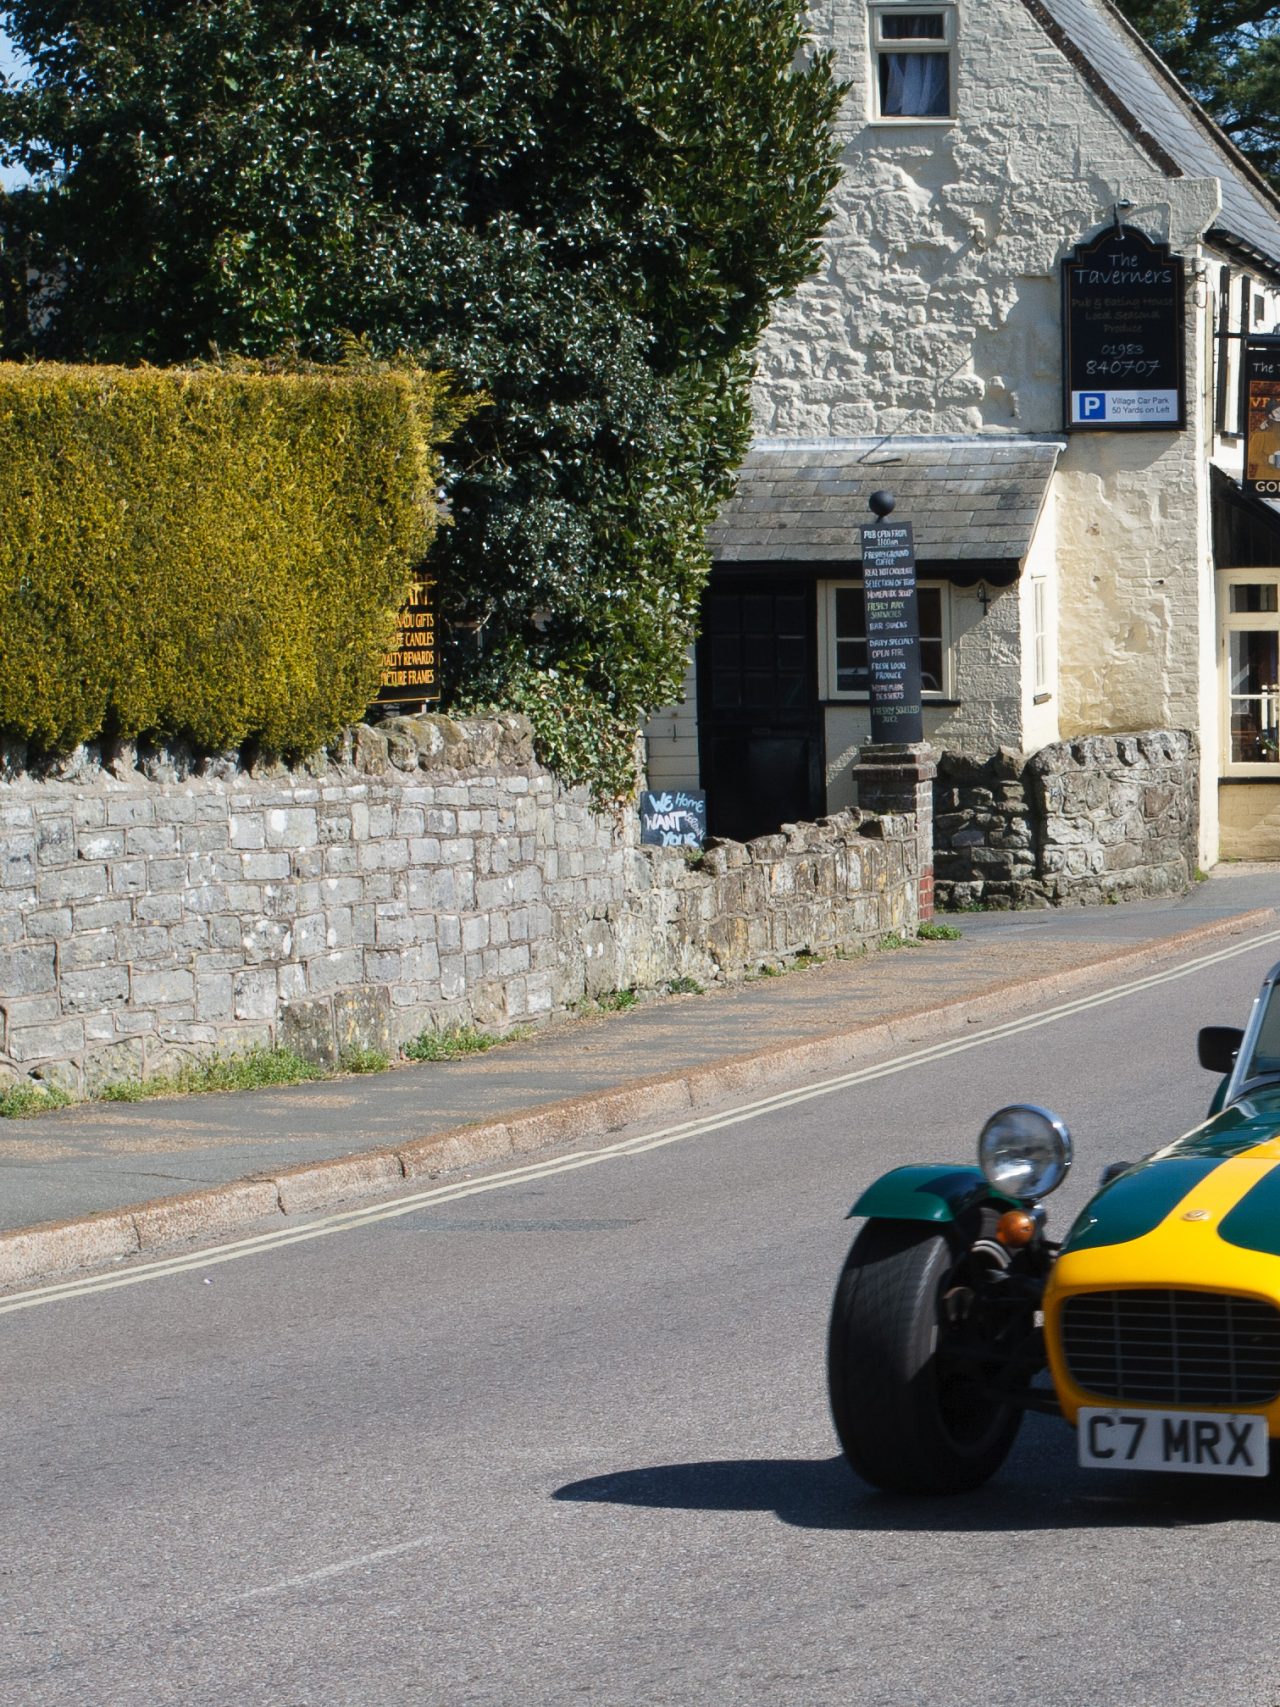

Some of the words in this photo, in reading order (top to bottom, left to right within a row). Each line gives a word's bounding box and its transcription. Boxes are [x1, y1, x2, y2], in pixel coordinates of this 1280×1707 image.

[1108, 252, 1138, 267] The
[1074, 269, 1173, 284] Taverners
[1101, 344, 1144, 359] 01983
[1086, 360, 1161, 377] 840707
[1252, 362, 1274, 373] The
[1084, 397, 1101, 416] P
[1111, 396, 1136, 406] Village
[1137, 396, 1151, 404] Car
[1152, 396, 1169, 404] Park
[1111, 406, 1121, 414] 50
[1122, 406, 1143, 414] Yards
[1155, 406, 1170, 414] Left
[877, 530, 890, 538] OPEN
[416, 613, 434, 628] GIFTS
[405, 632, 435, 647] CANDLES
[403, 650, 435, 666] REWARDS
[872, 649, 890, 659] OPEN
[408, 669, 435, 685] FRAMES
[648, 792, 673, 813] WE
[644, 810, 687, 832] WANT
[660, 831, 699, 848] YOUR
[1088, 1415, 1148, 1460] C7
[1162, 1417, 1255, 1467] MRX
